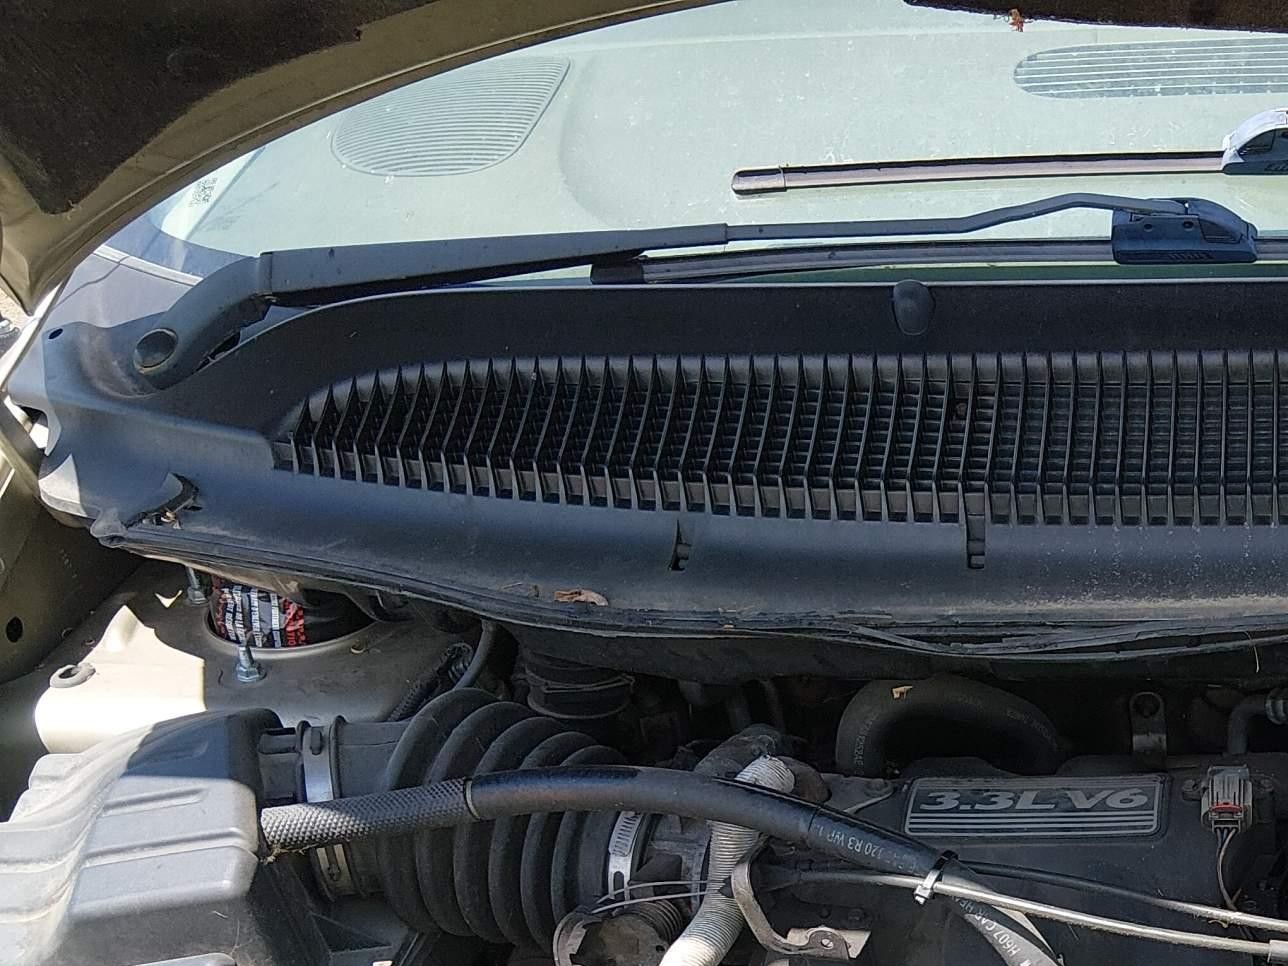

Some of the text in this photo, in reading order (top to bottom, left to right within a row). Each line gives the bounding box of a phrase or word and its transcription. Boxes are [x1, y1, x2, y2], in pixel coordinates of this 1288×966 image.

[919, 787, 1148, 811] 3.3L V6
[990, 931, 1021, 957] H607
